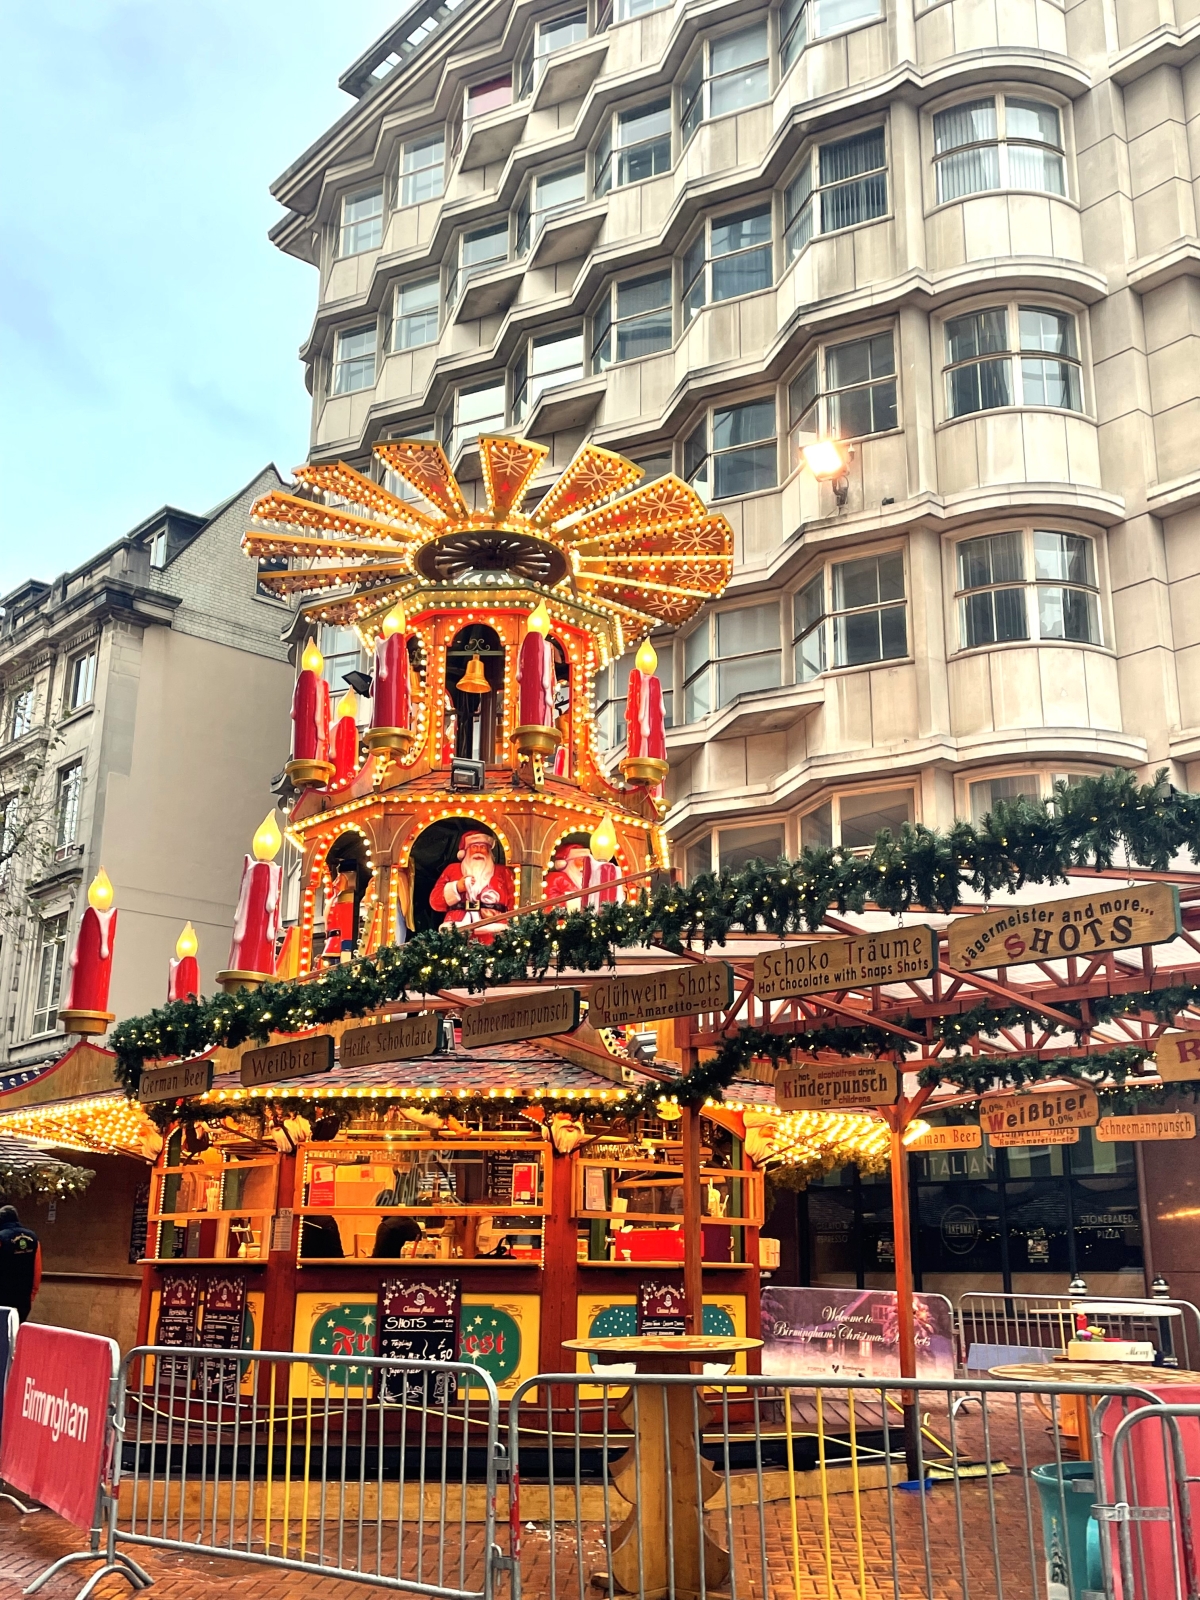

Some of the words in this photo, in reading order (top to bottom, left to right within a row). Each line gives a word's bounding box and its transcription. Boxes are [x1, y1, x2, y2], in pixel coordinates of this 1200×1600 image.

[960, 907, 1054, 967] Jägermeister
[1062, 903, 1093, 923] and
[1100, 898, 1154, 916] more...
[1004, 915, 1133, 960] SHOTS
[763, 946, 829, 979] Schoko
[843, 936, 922, 965] Träume
[758, 981, 776, 994] Hot
[779, 973, 830, 991] Chocolate
[833, 967, 857, 983] with
[861, 965, 893, 979] Snaps
[897, 958, 929, 973] Shots
[594, 979, 667, 1014] Glühwein
[678, 970, 721, 998] Shots
[465, 995, 568, 1037] Schneemannpunsch
[604, 997, 724, 1023] Rum-Amaretto-etc.
[344, 1035, 370, 1057] Heiße
[376, 1024, 432, 1053] Schokolade
[252, 1048, 317, 1078] Weißbier
[798, 1073, 810, 1081] hot
[818, 1069, 856, 1079] alcoholfree
[858, 1067, 876, 1076] drink
[142, 1076, 178, 1098] German
[184, 1069, 205, 1088] Beer
[783, 1073, 888, 1100] Kinderpunsch
[820, 1098, 831, 1106] for
[839, 1095, 871, 1104] childrens
[988, 1094, 1087, 1132] Weißbier
[953, 1129, 976, 1143] Beer
[1100, 1116, 1191, 1136] Schneemannpunsch
[923, 1154, 995, 1176] ITALIAN
[1081, 1214, 1134, 1224] STONEBAKED
[1097, 1231, 1121, 1239] PIZZA
[384, 1316, 427, 1329] SHOTS
[821, 1305, 864, 1322] Welcome
[22, 1376, 89, 1443] Birmingham
